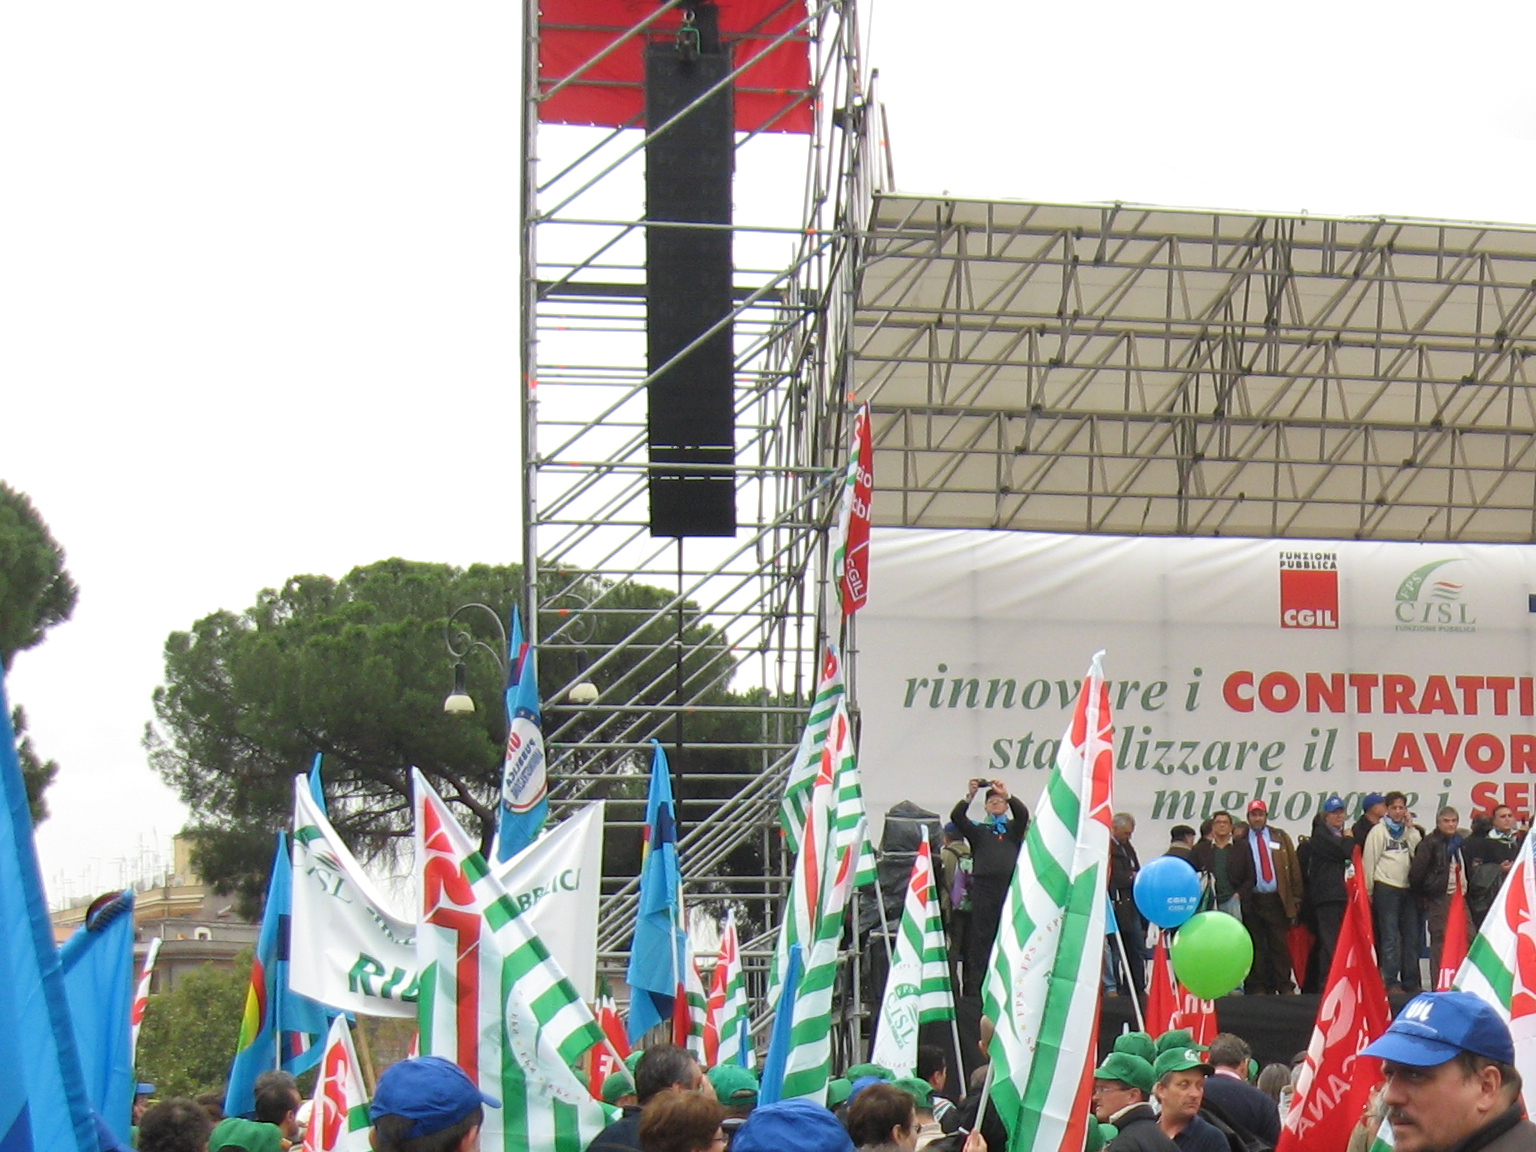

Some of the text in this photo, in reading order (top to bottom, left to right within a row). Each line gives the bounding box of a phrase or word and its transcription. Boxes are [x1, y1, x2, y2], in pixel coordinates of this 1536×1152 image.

[1280, 551, 1338, 561] FUNZIONE
[1280, 560, 1338, 570] PUBBLICA
[1283, 608, 1337, 626] CGIL
[1395, 601, 1477, 624] CISL
[903, 662, 1534, 717] rinnovre i CONTRATTI
[989, 726, 1286, 775] stalizzare
[1303, 727, 1339, 772] il
[1150, 776, 1419, 824] miglior
